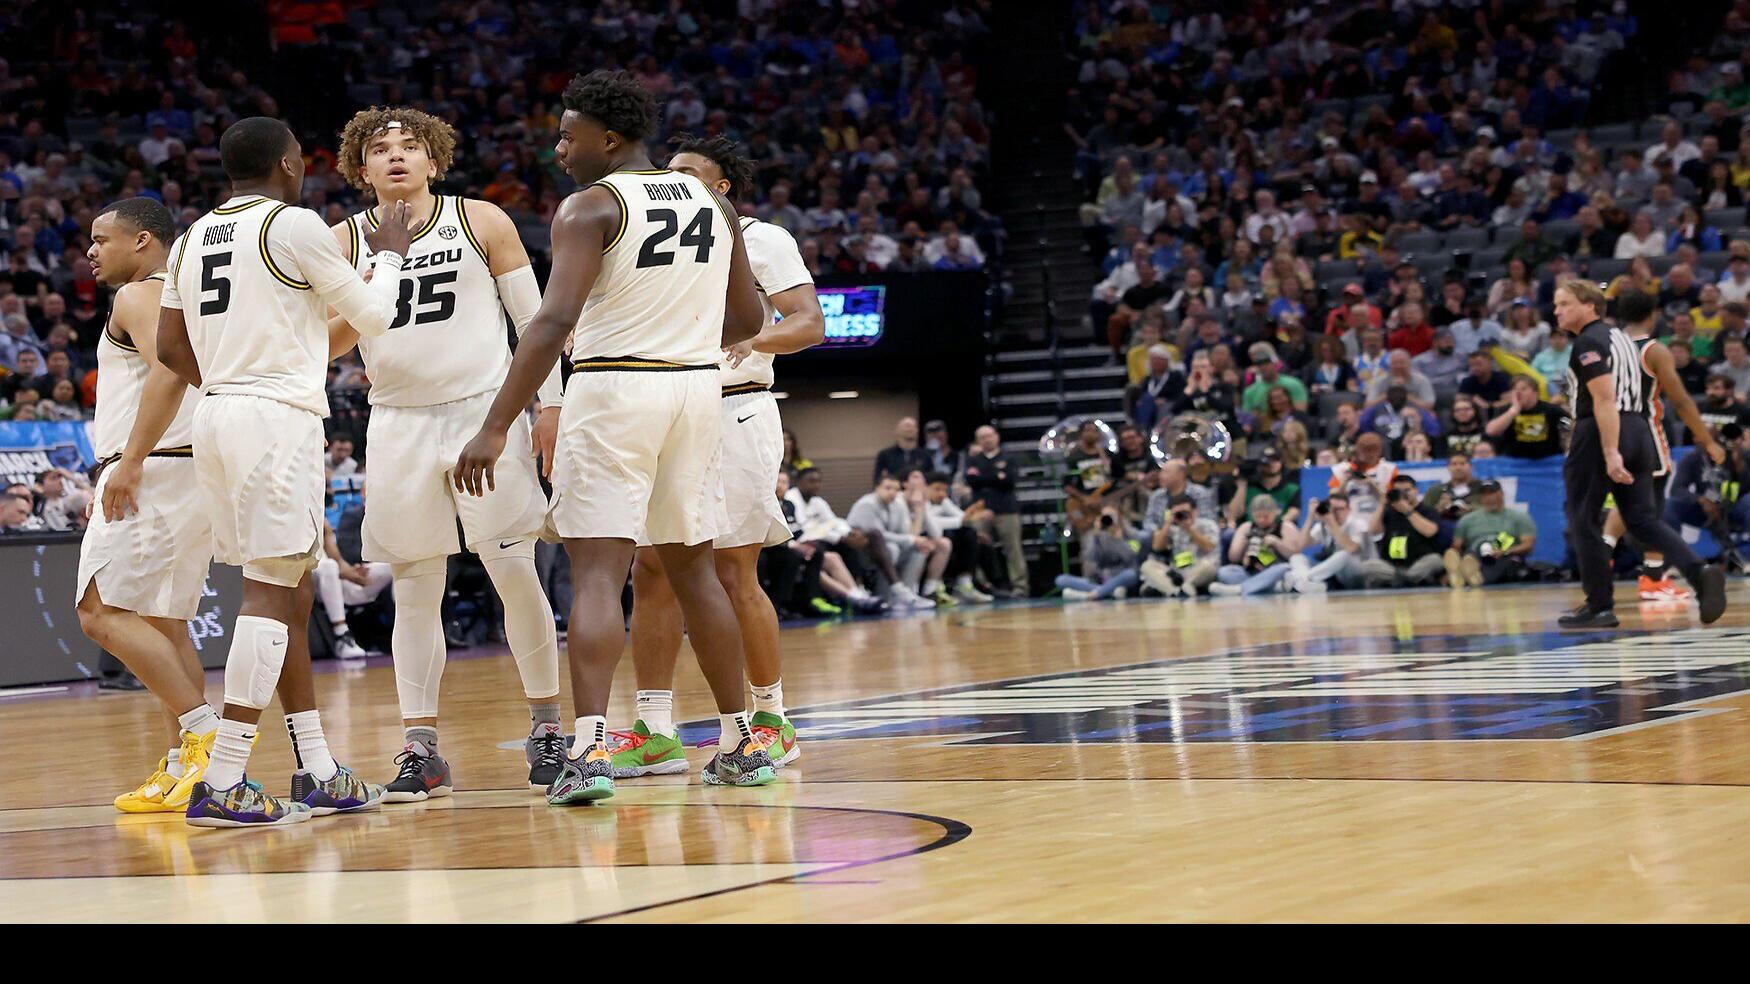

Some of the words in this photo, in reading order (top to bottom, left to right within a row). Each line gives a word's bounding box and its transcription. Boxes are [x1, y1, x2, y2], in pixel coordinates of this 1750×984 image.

[643, 182, 693, 201] BROWN
[202, 221, 238, 247] HODGE
[438, 225, 458, 240] SEC
[636, 207, 716, 269] 24
[400, 247, 463, 272] ZZOU
[199, 250, 233, 317] 5
